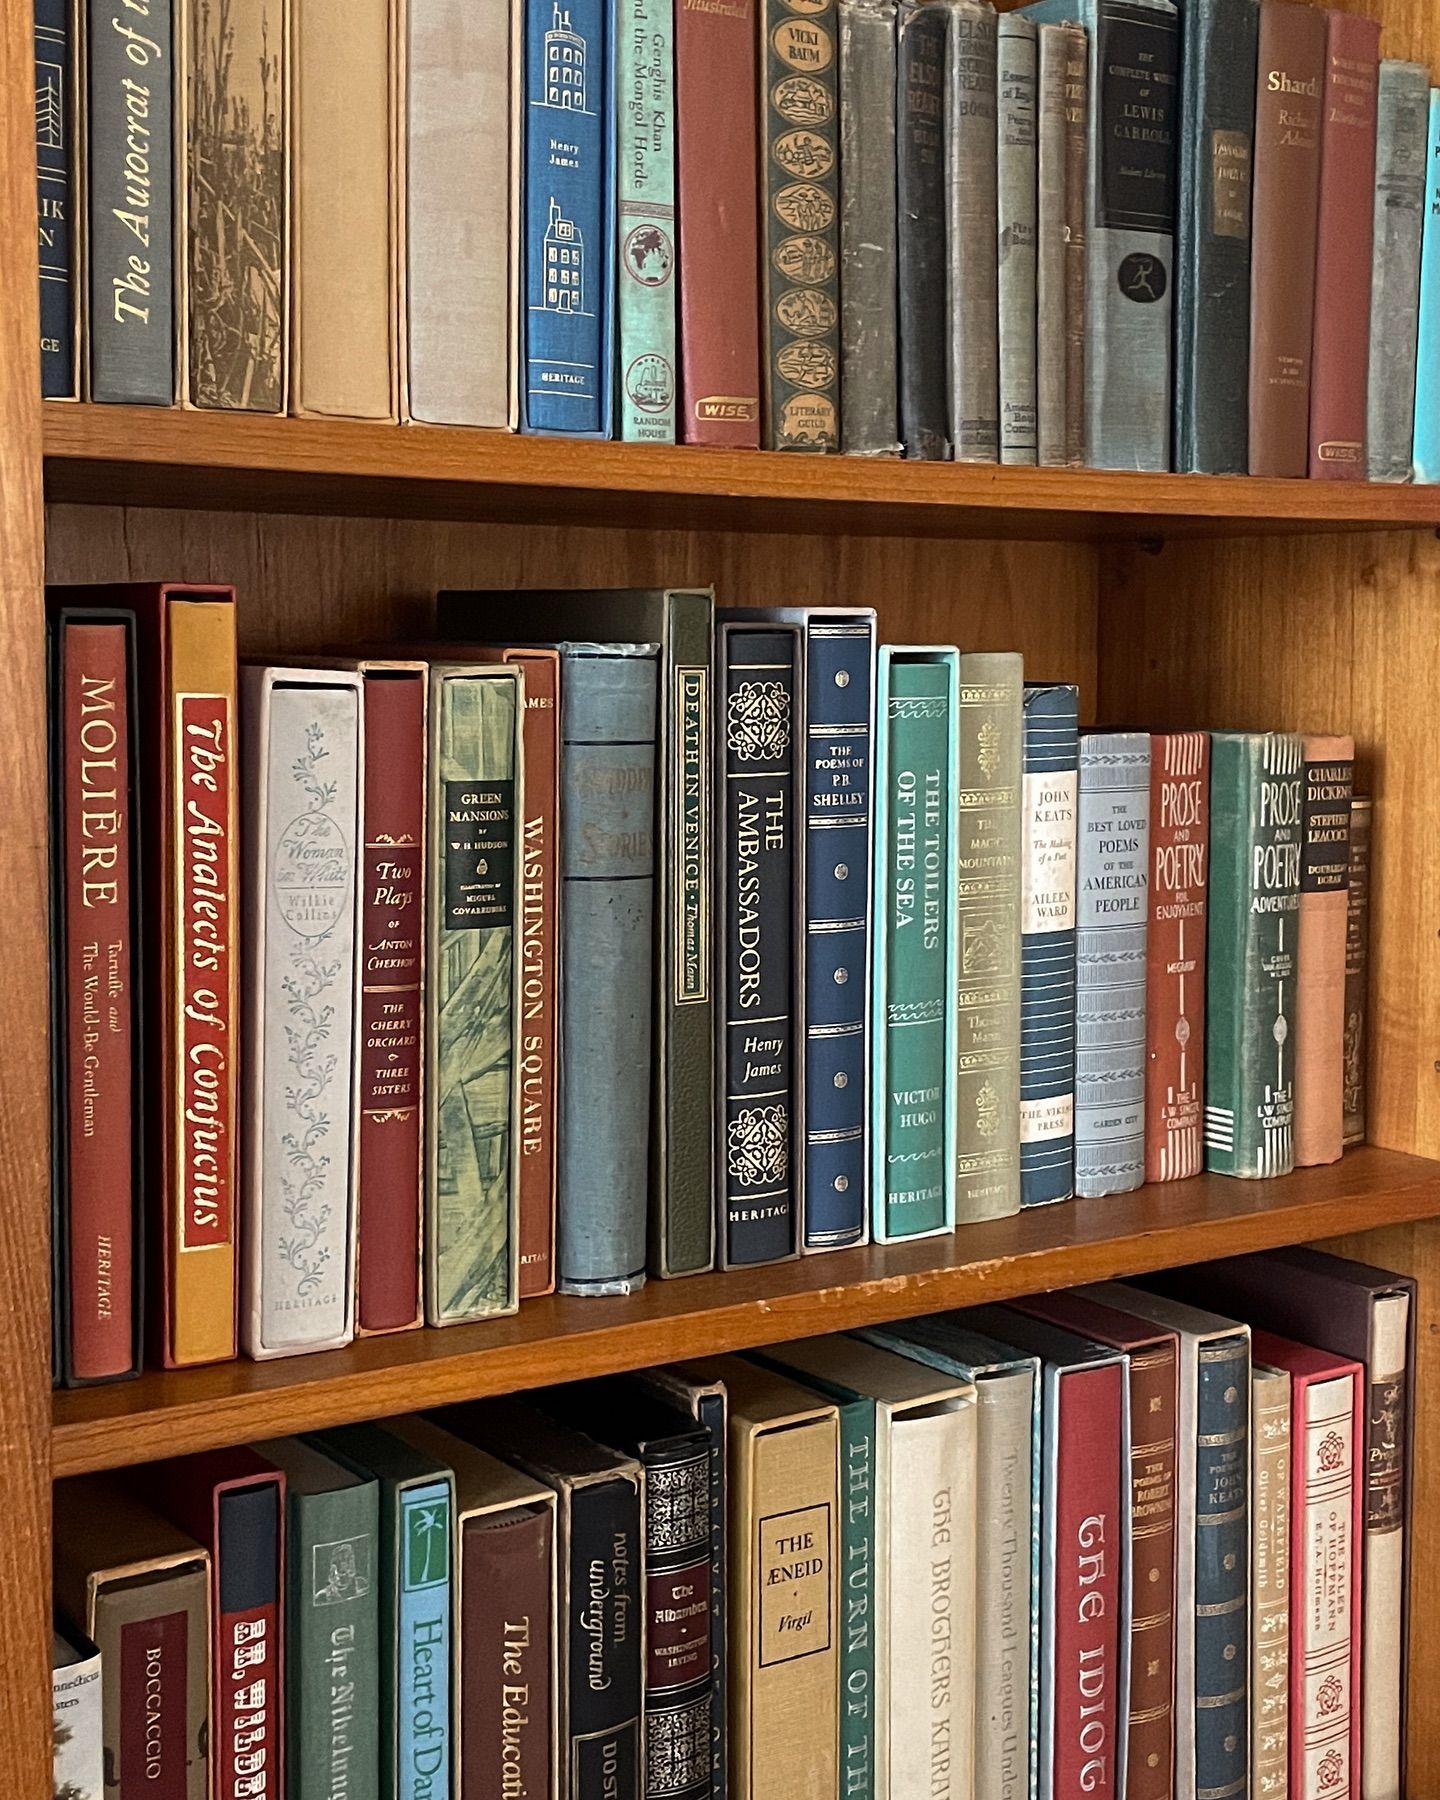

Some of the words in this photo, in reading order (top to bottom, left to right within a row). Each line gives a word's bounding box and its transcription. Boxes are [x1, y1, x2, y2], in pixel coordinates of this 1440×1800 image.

[112, 18, 162, 66] of
[634, 28, 648, 54] the
[788, 28, 818, 46] VICKI
[789, 46, 820, 63] BAUM
[1138, 53, 1154, 62] THE
[648, 33, 666, 101] Genghis
[1109, 66, 1151, 80] COMPLETE
[628, 62, 648, 128] Mongol
[1124, 104, 1164, 121] LEWIS
[653, 110, 666, 152] Khan
[550, 139, 579, 154] Henry
[112, 78, 150, 247] Autocrat
[549, 155, 579, 169] James
[634, 135, 649, 189] Horde
[114, 255, 150, 324] The
[542, 372, 585, 385] HERITAGE
[633, 417, 671, 428] RANDOM
[704, 405, 747, 418] WISE
[790, 406, 832, 418] LITERARY
[639, 429, 667, 440] HOUSE
[798, 419, 825, 430] GUILD
[685, 681, 699, 765] DEATH
[187, 719, 226, 792] The
[829, 746, 852, 757] THE
[815, 758, 851, 770] POEMS
[853, 757, 865, 768] OF
[80, 674, 122, 909] MOLIÈRE
[685, 773, 699, 797] IN
[897, 771, 916, 807] OF
[461, 793, 501, 805] GREEN
[813, 793, 865, 807] SHELLEY
[925, 769, 940, 828] THE
[1038, 790, 1070, 806] JOHN
[1161, 781, 1201, 827] PROSE
[1260, 782, 1301, 827] PROSE
[450, 810, 508, 822] MANSIONS
[764, 790, 784, 850] THE
[1035, 809, 1072, 823] KEATS
[1112, 805, 1127, 815] THE
[295, 818, 332, 838] The
[1087, 821, 1112, 833] BEST
[1118, 818, 1146, 832] LOVED
[1174, 830, 1189, 841] AND
[1274, 829, 1291, 841] AND
[283, 839, 343, 859] Woman
[474, 842, 507, 850] HUDSON
[685, 806, 699, 890] VENICE
[896, 814, 916, 871] THE
[1033, 840, 1047, 850] The
[1049, 840, 1072, 851] Making
[1098, 838, 1139, 854] POEMS
[958, 855, 1014, 869] MOUNTAIN
[1038, 853, 1046, 864] of
[1104, 862, 1115, 871] OF
[1118, 861, 1134, 870] THE
[1155, 844, 1205, 891] POETRY
[1253, 844, 1301, 890] POETRY
[297, 860, 346, 883] White
[376, 862, 411, 880] Two
[187, 800, 227, 971] Analects
[923, 834, 940, 950] TOILERS
[1083, 874, 1147, 891] AMERICAN
[373, 888, 412, 911] Plays
[466, 895, 495, 903] MIGUEL
[737, 791, 761, 1009] AMBASSADORS
[895, 879, 915, 929] SEA
[1032, 891, 1070, 906] AILEEN
[1095, 897, 1140, 913] PEOPLE
[286, 908, 337, 922] Collins
[452, 905, 507, 916] COVARRUBIAS
[523, 816, 544, 1020] WASHINGTON
[1037, 905, 1068, 918] WARD
[1157, 902, 1204, 920] ENJOYMENT
[388, 920, 400, 929] OF
[686, 904, 698, 951] Thomas
[83, 942, 99, 970] The
[369, 939, 412, 952] ANTON
[108, 939, 124, 999] Tartuffe
[367, 957, 414, 971] CHEKHOV
[686, 952, 698, 989] Mann
[185, 988, 226, 1032] of
[383, 1003, 404, 1013] THE
[109, 1008, 122, 1032] and
[371, 1020, 412, 1032] CHERRY
[367, 1036, 415, 1048] ORCHARD
[744, 1037, 784, 1057] Henry
[375, 1068, 409, 1079] THREE
[743, 1062, 782, 1084] James
[84, 1057, 99, 1138] Gentleman
[372, 1084, 411, 1096] SISTERS
[521, 1036, 544, 1156] SQUARE
[893, 1087, 941, 1106] VICTOR
[900, 1111, 936, 1128] HUGO
[1019, 1110, 1042, 1121] THE
[1037, 1118, 1065, 1132] PRESS
[1093, 1118, 1122, 1129] GARDEN
[1166, 1115, 1198, 1129] COMPANY
[186, 1043, 226, 1228] Confucius
[97, 1234, 112, 1320] HERITAGE
[273, 1294, 337, 1311] HERITAGE
[849, 1435, 869, 1523] THE
[1146, 1463, 1164, 1474] THE
[1276, 1458, 1285, 1481] OF
[1001, 1447, 1018, 1528] Twenty
[1133, 1475, 1162, 1489] POEMS
[1163, 1471, 1172, 1481] OF
[1258, 1470, 1269, 1512] Oliver
[1137, 1485, 1169, 1502] ROBERT
[1329, 1511, 1337, 1533] OF
[776, 1532, 815, 1555] THE
[1276, 1487, 1286, 1590] WAKEFIELD
[612, 1532, 628, 1584] notes
[1258, 1519, 1269, 1589] Goldsmith
[767, 1558, 823, 1586] ÆNEID
[671, 1584, 694, 1601] The
[848, 1537, 869, 1653] TURN
[1001, 1531, 1017, 1640] Thousand
[1328, 1538, 1337, 1632] HOFFMANN
[1337, 1561, 1345, 1615] TALES
[1315, 1568, 1323, 1631] Hoffmann
[613, 1592, 631, 1644] from
[655, 1601, 707, 1624] Alhambra
[779, 1610, 812, 1632] Virgil
[581, 1560, 612, 1691] underground
[325, 1624, 355, 1678] The
[503, 1616, 530, 1676] The
[654, 1636, 707, 1656] WASHINGTON
[413, 1614, 443, 1707] Heart
[667, 1653, 698, 1668] IRVING
[847, 1668, 868, 1719] OF
[998, 1643, 1017, 1732] Leagues
[145, 1646, 162, 1781] BOCCACCIO
[413, 1710, 444, 1737] of
